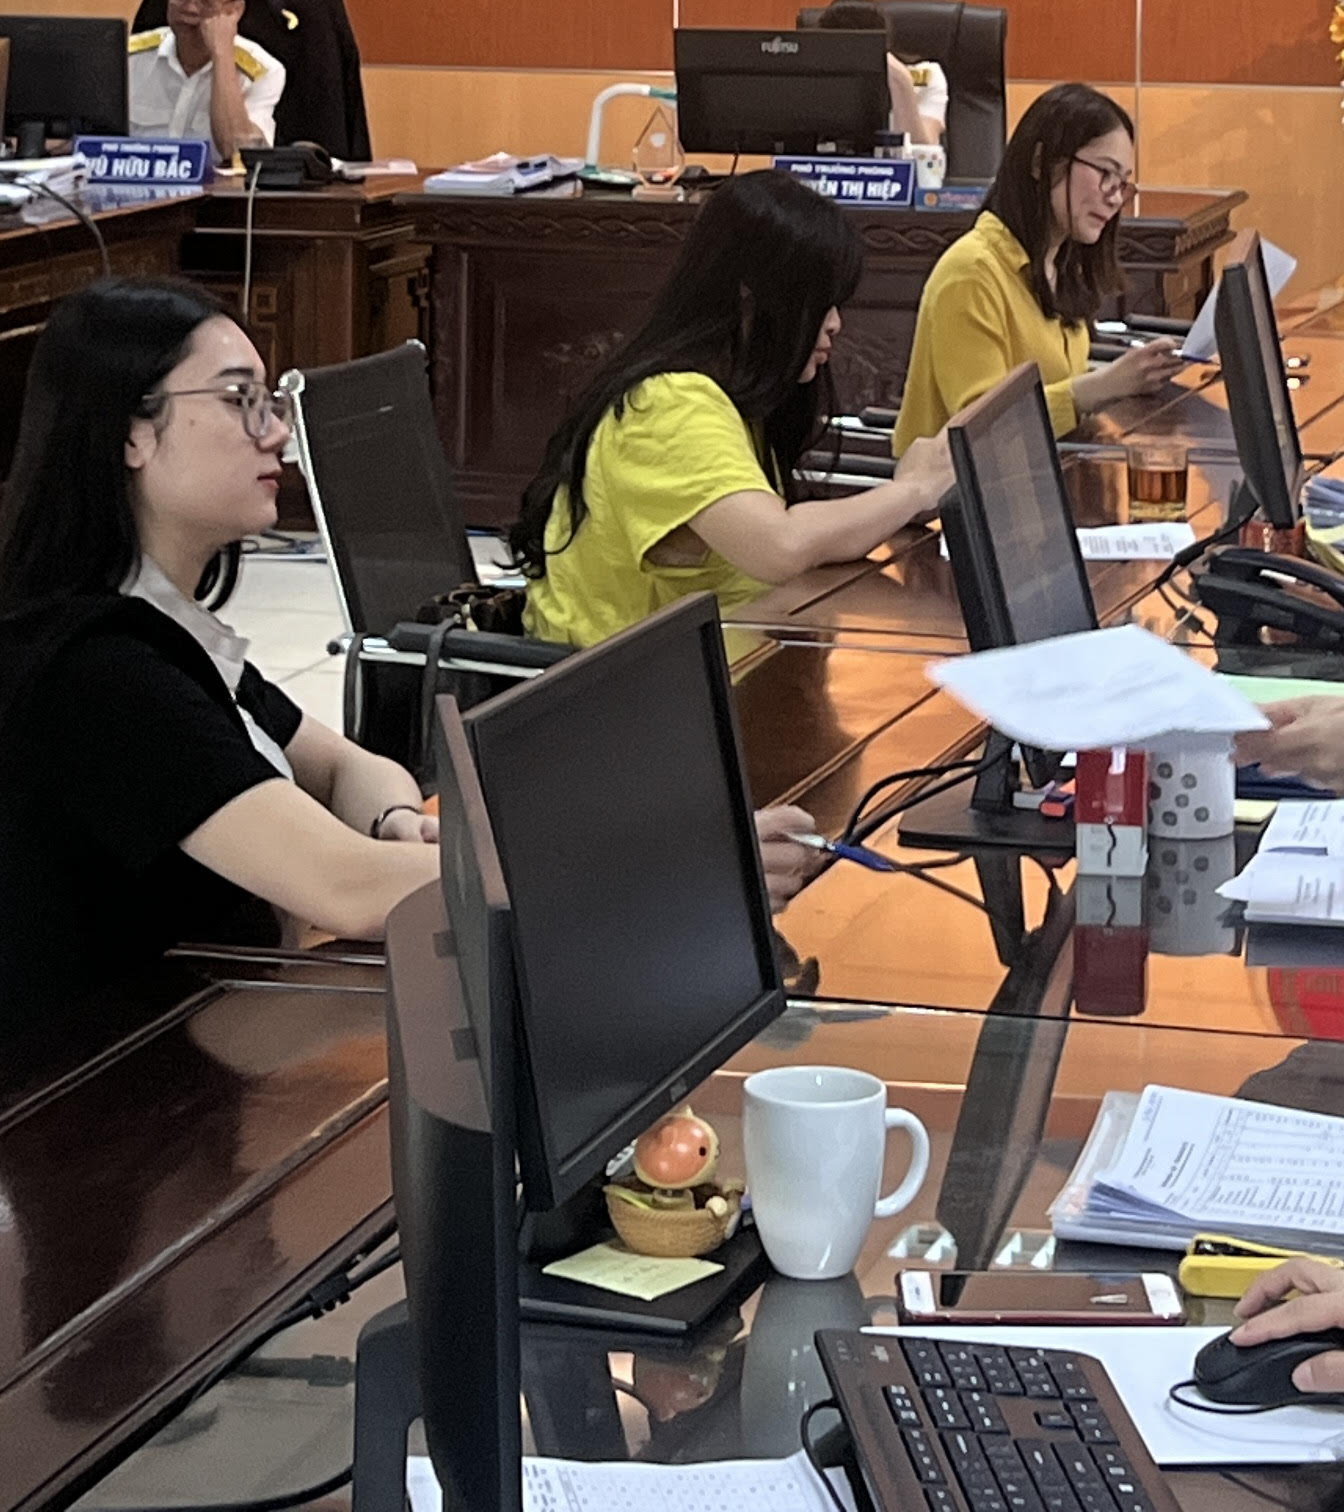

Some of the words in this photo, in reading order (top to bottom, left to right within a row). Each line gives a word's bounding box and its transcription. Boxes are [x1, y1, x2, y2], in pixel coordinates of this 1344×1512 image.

[761, 36, 799, 54] FUJITSU
[841, 180, 864, 201] THỊ
[867, 178, 902, 201] HIỆP
